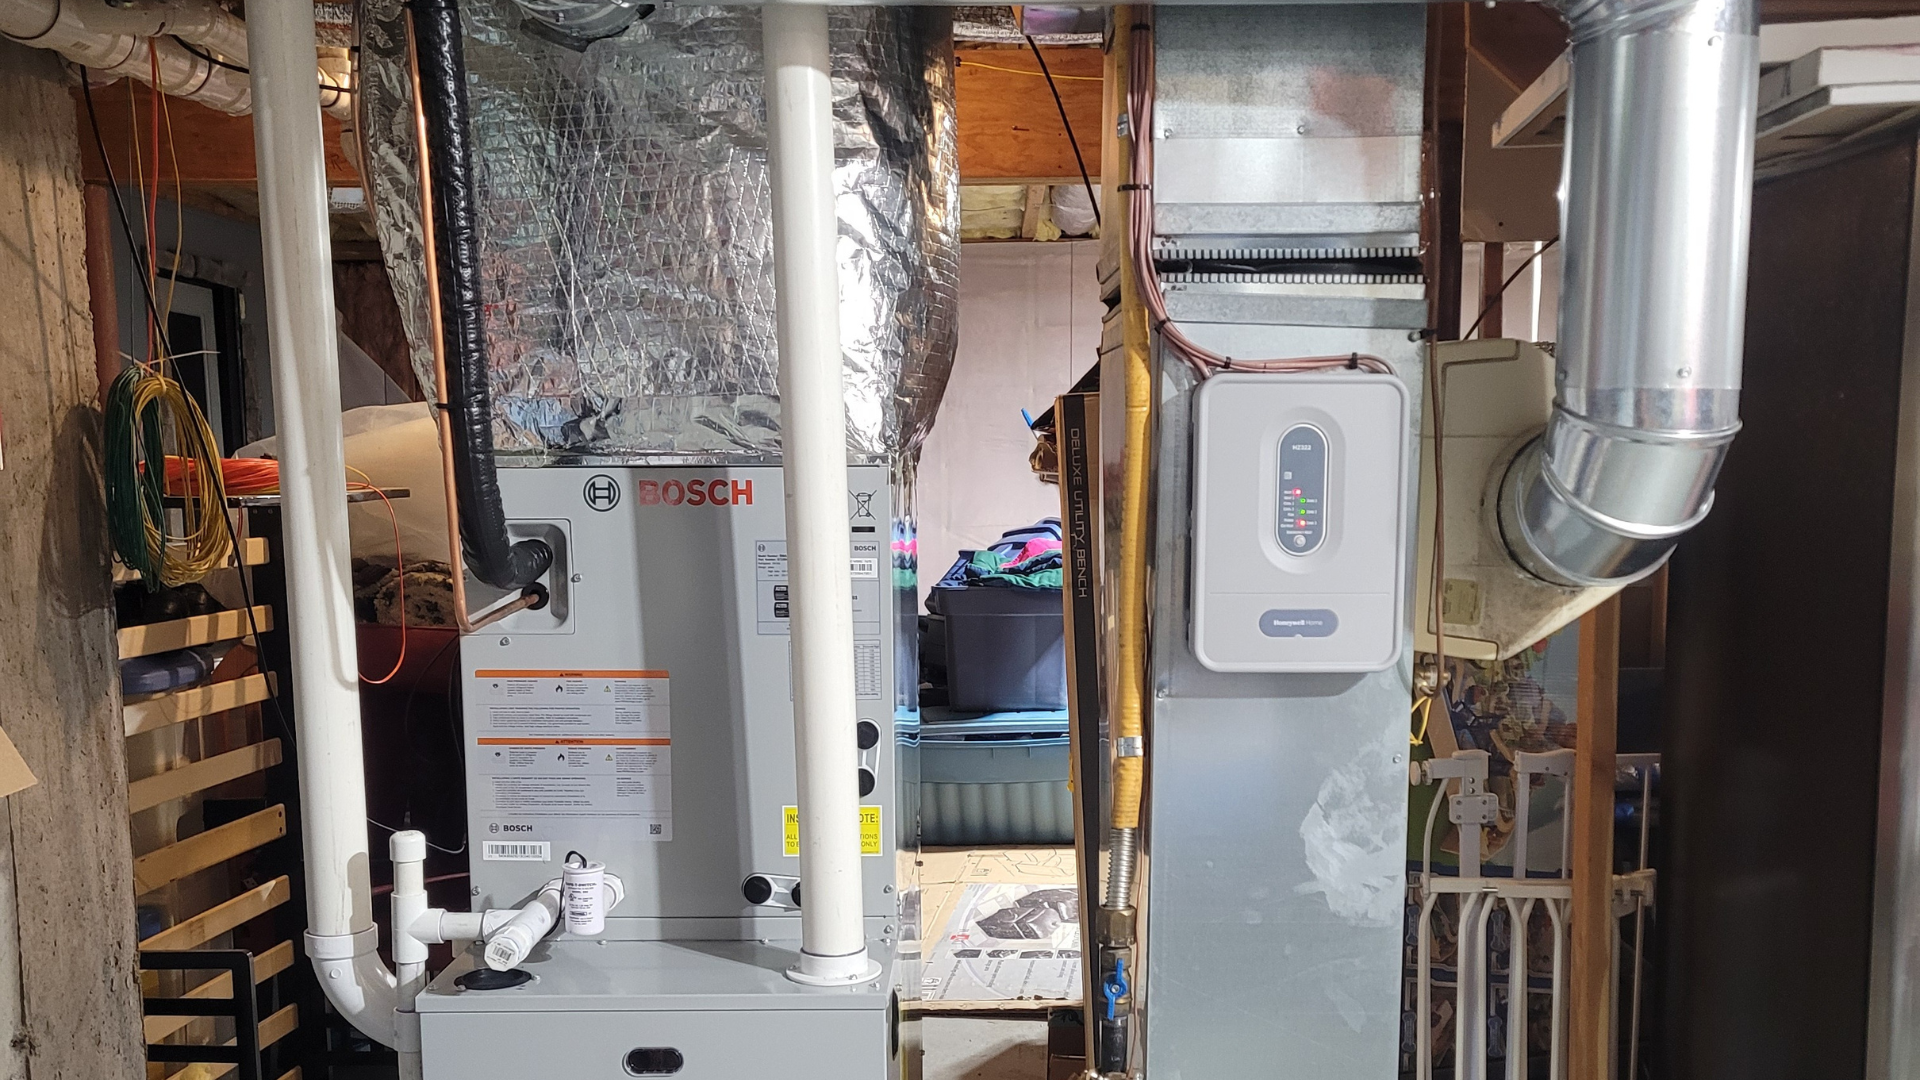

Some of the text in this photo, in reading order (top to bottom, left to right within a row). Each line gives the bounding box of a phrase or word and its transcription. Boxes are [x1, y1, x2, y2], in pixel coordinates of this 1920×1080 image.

[639, 479, 753, 506] BOSCH
[1070, 428, 1088, 597] DELUXE UTILITY BENCH
[1273, 619, 1305, 627] Honeywell
[786, 813, 879, 823] INS OTE:
[503, 824, 533, 832] BOSCH
